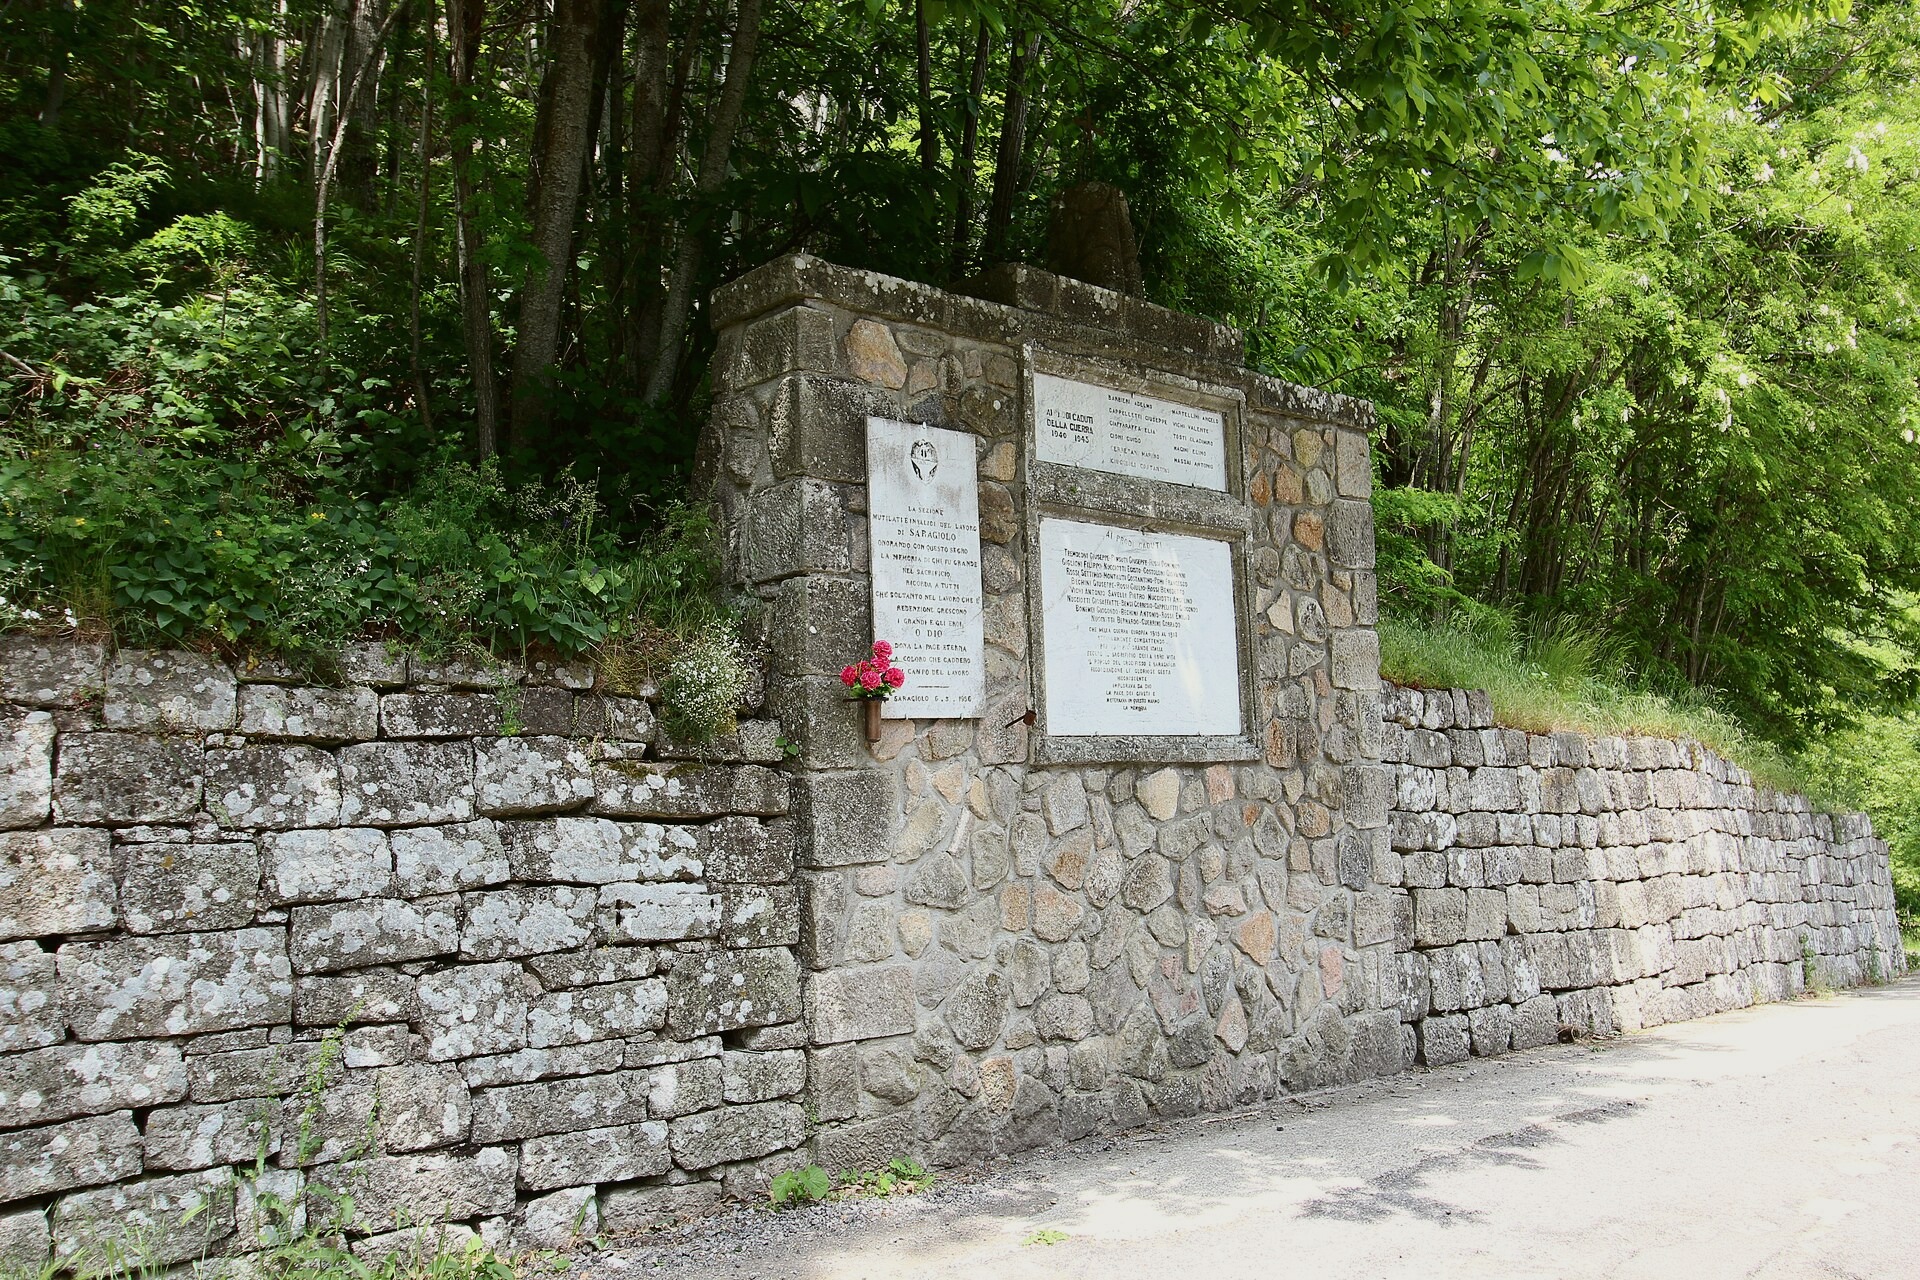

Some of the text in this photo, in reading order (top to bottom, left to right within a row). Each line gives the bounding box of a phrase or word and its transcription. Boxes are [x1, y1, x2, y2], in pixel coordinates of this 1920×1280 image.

[1072, 413, 1093, 425] CADUTI
[1145, 416, 1167, 426] GIUSEPPE
[1203, 416, 1218, 424] ANGELO
[1047, 419, 1094, 435] DELLA GUERRA
[1052, 430, 1090, 444] 1940 1945
[1194, 462, 1214, 470] ANTONIO
[919, 507, 944, 516] SEZIONE
[873, 514, 903, 523] MUTILATI
[910, 519, 936, 527] INVALIDI
[956, 524, 977, 532] LAVORO
[910, 529, 957, 541] SARAGIOLO
[878, 540, 911, 549] ONORANDO
[927, 545, 949, 553] QUESTO
[893, 554, 921, 563] MEMORIA
[954, 560, 978, 568] GRANDE
[906, 580, 932, 588] RICORDA
[876, 591, 889, 599] CHE
[890, 592, 923, 600] SOLTANTO
[897, 605, 967, 616] REDENZIONE CRESCONO
[927, 630, 943, 638] DIO
[943, 644, 967, 653] ETERNA
[894, 695, 929, 703] SARAGIOLO
